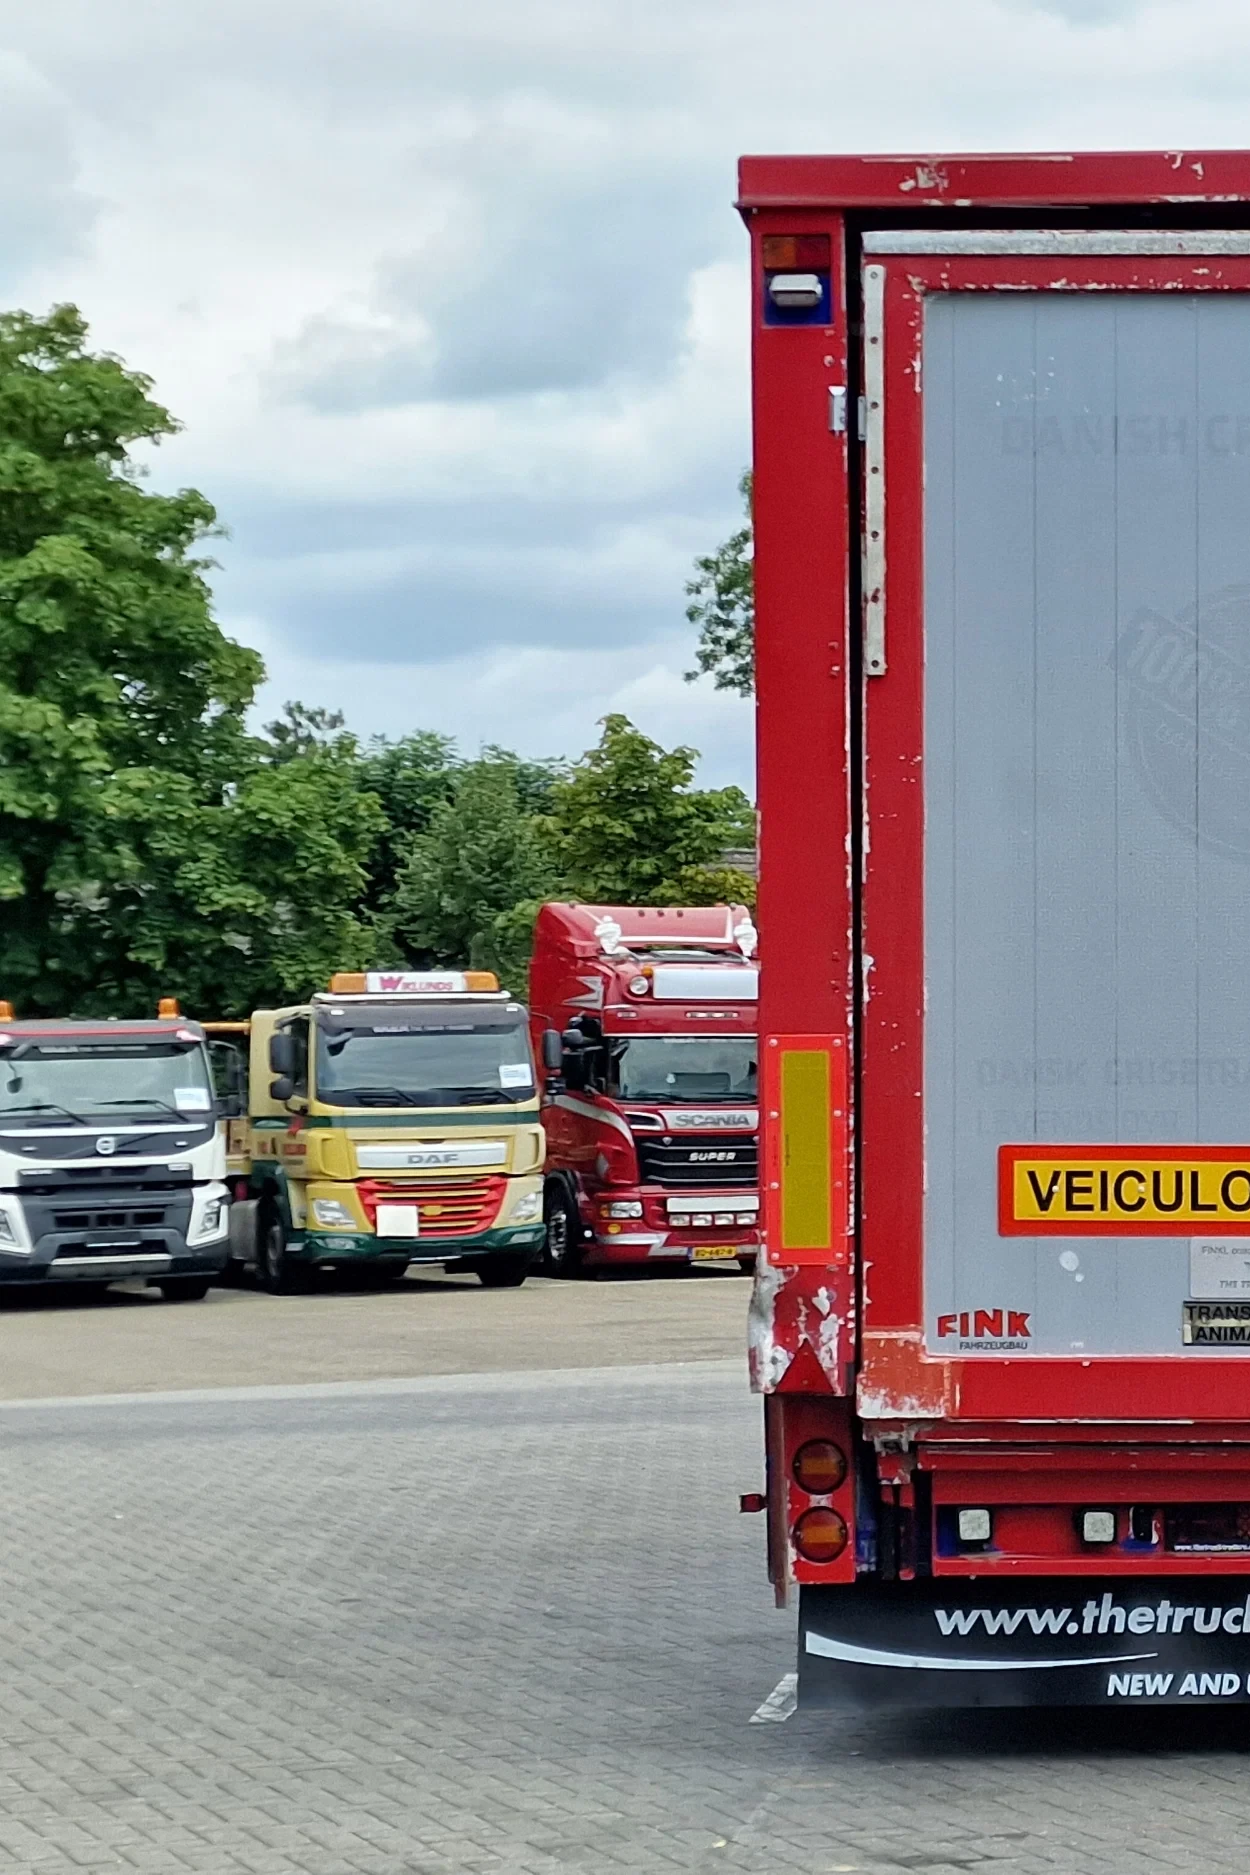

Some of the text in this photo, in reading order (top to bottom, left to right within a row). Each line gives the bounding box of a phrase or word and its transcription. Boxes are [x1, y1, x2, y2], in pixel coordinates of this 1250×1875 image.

[1002, 414, 1188, 456] DANISH
[674, 1114, 750, 1127] SCANIA
[407, 1153, 460, 1165] DAF
[689, 1152, 736, 1161] SUPER
[959, 1341, 1028, 1351] FAHRZEUGBAU
[1107, 1673, 1174, 1697] NEW
[1178, 1673, 1241, 1697] AND
